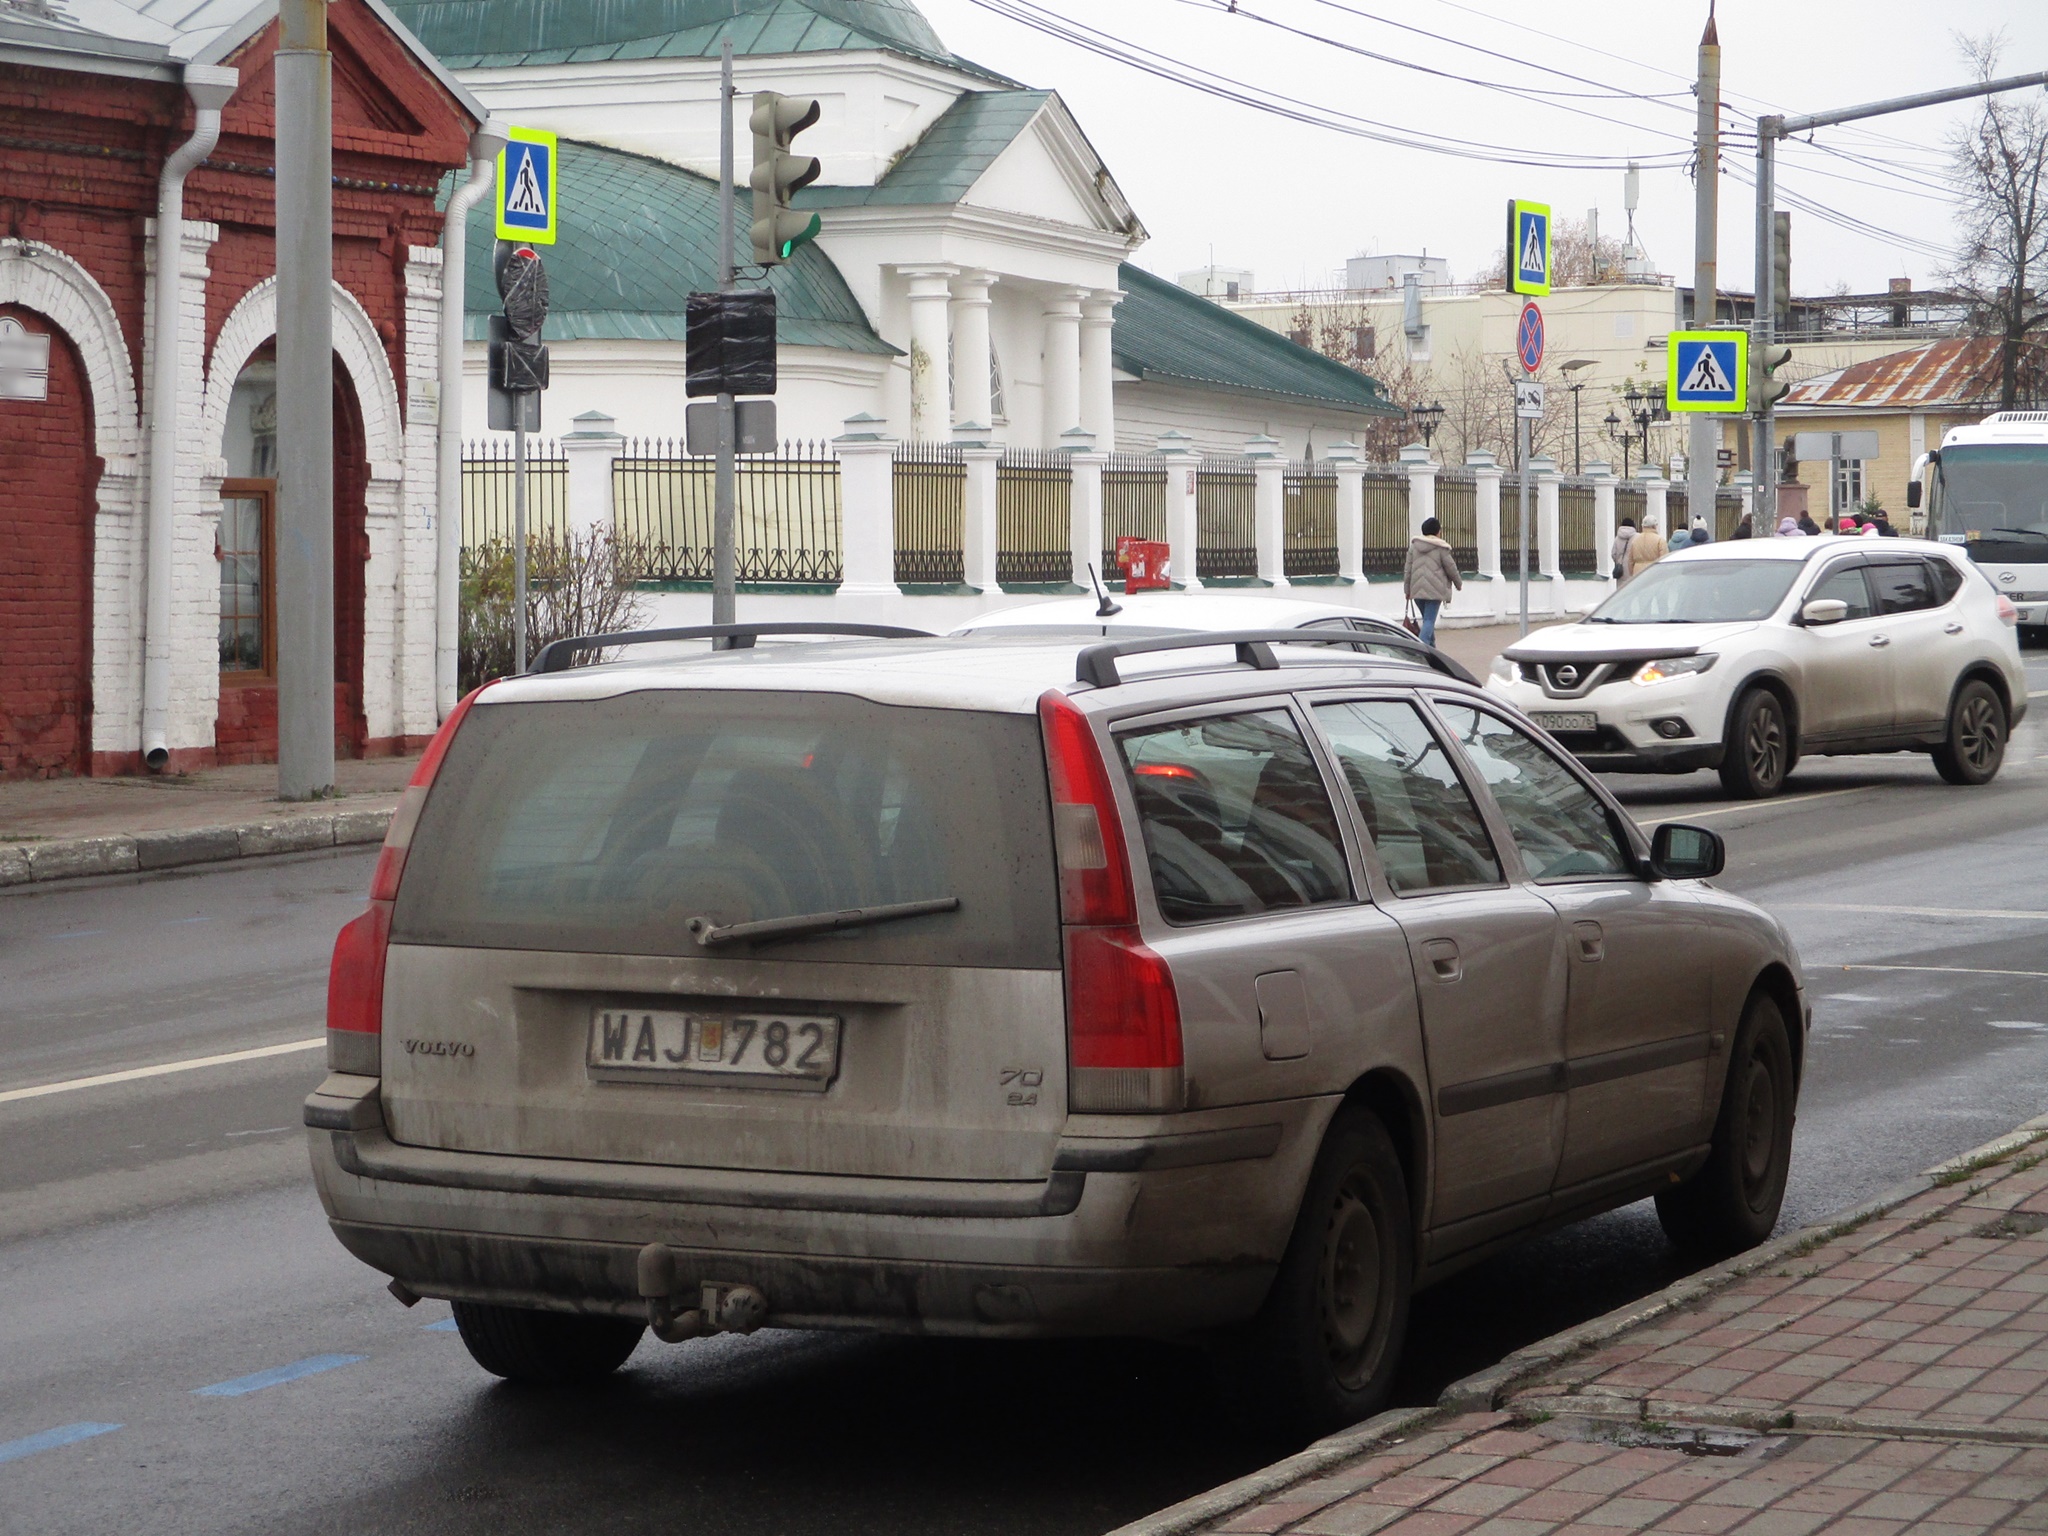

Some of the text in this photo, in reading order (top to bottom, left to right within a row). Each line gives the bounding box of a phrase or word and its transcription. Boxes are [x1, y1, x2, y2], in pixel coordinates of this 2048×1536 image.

[400, 1038, 475, 1057] VOLVO
[602, 1013, 823, 1070] WAJ 782
[1000, 1068, 1044, 1087] 70
